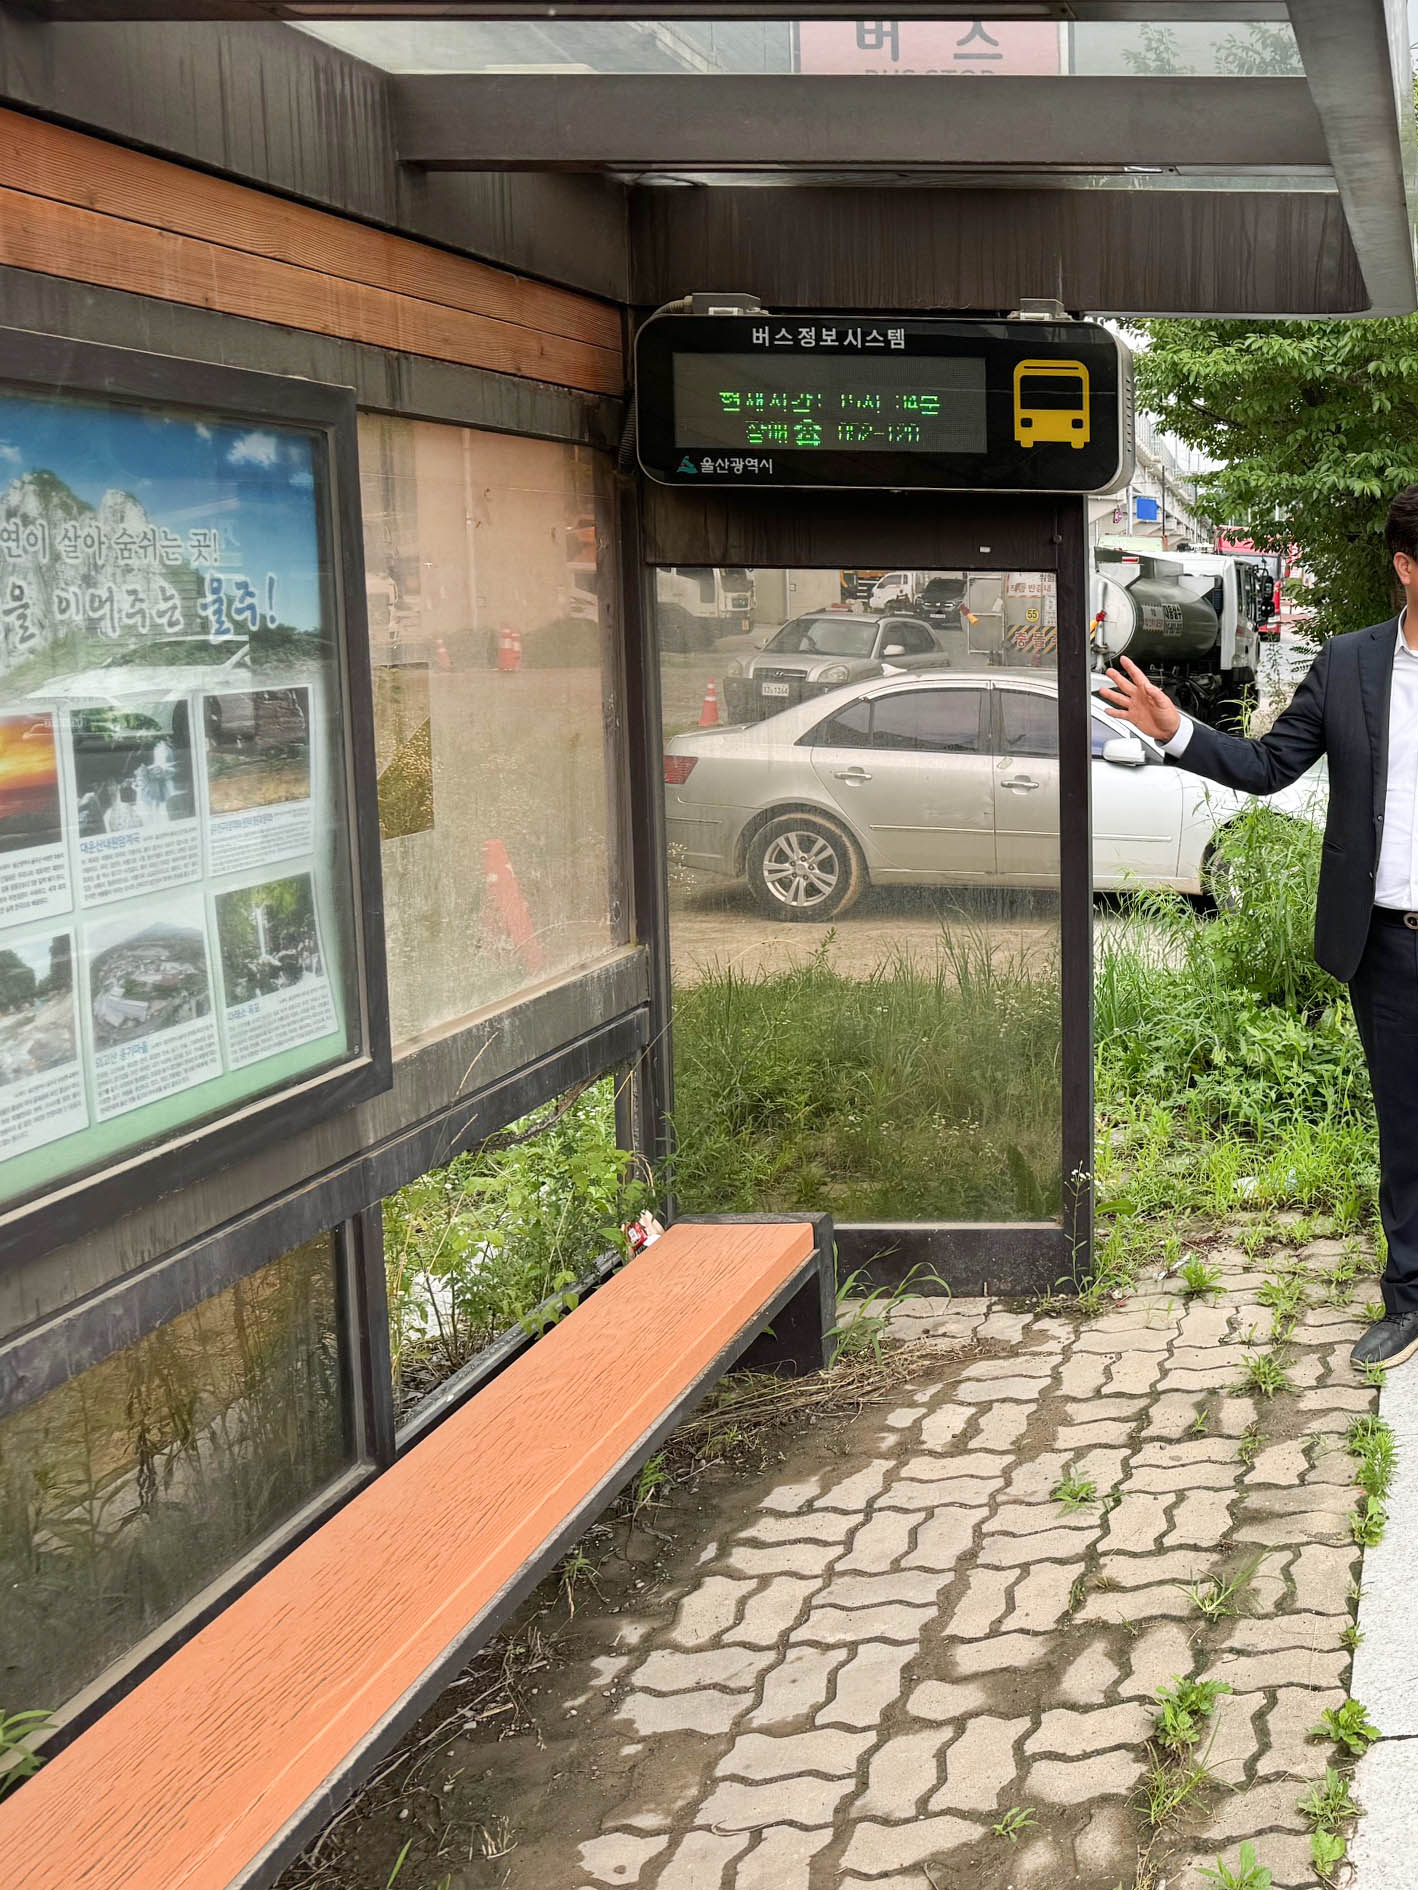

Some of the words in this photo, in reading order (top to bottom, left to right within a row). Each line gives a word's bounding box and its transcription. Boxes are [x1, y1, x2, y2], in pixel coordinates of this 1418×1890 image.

[856, 21, 1003, 62] 버스
[752, 326, 906, 349] 버스정보시스템
[700, 457, 773, 474] 울산광역시
[58, 523, 104, 563] 살아
[114, 526, 182, 564] 숨쉬는
[190, 530, 220, 564] 곳!
[55, 585, 183, 636] 이어주는
[1027, 610, 1038, 619] 55
